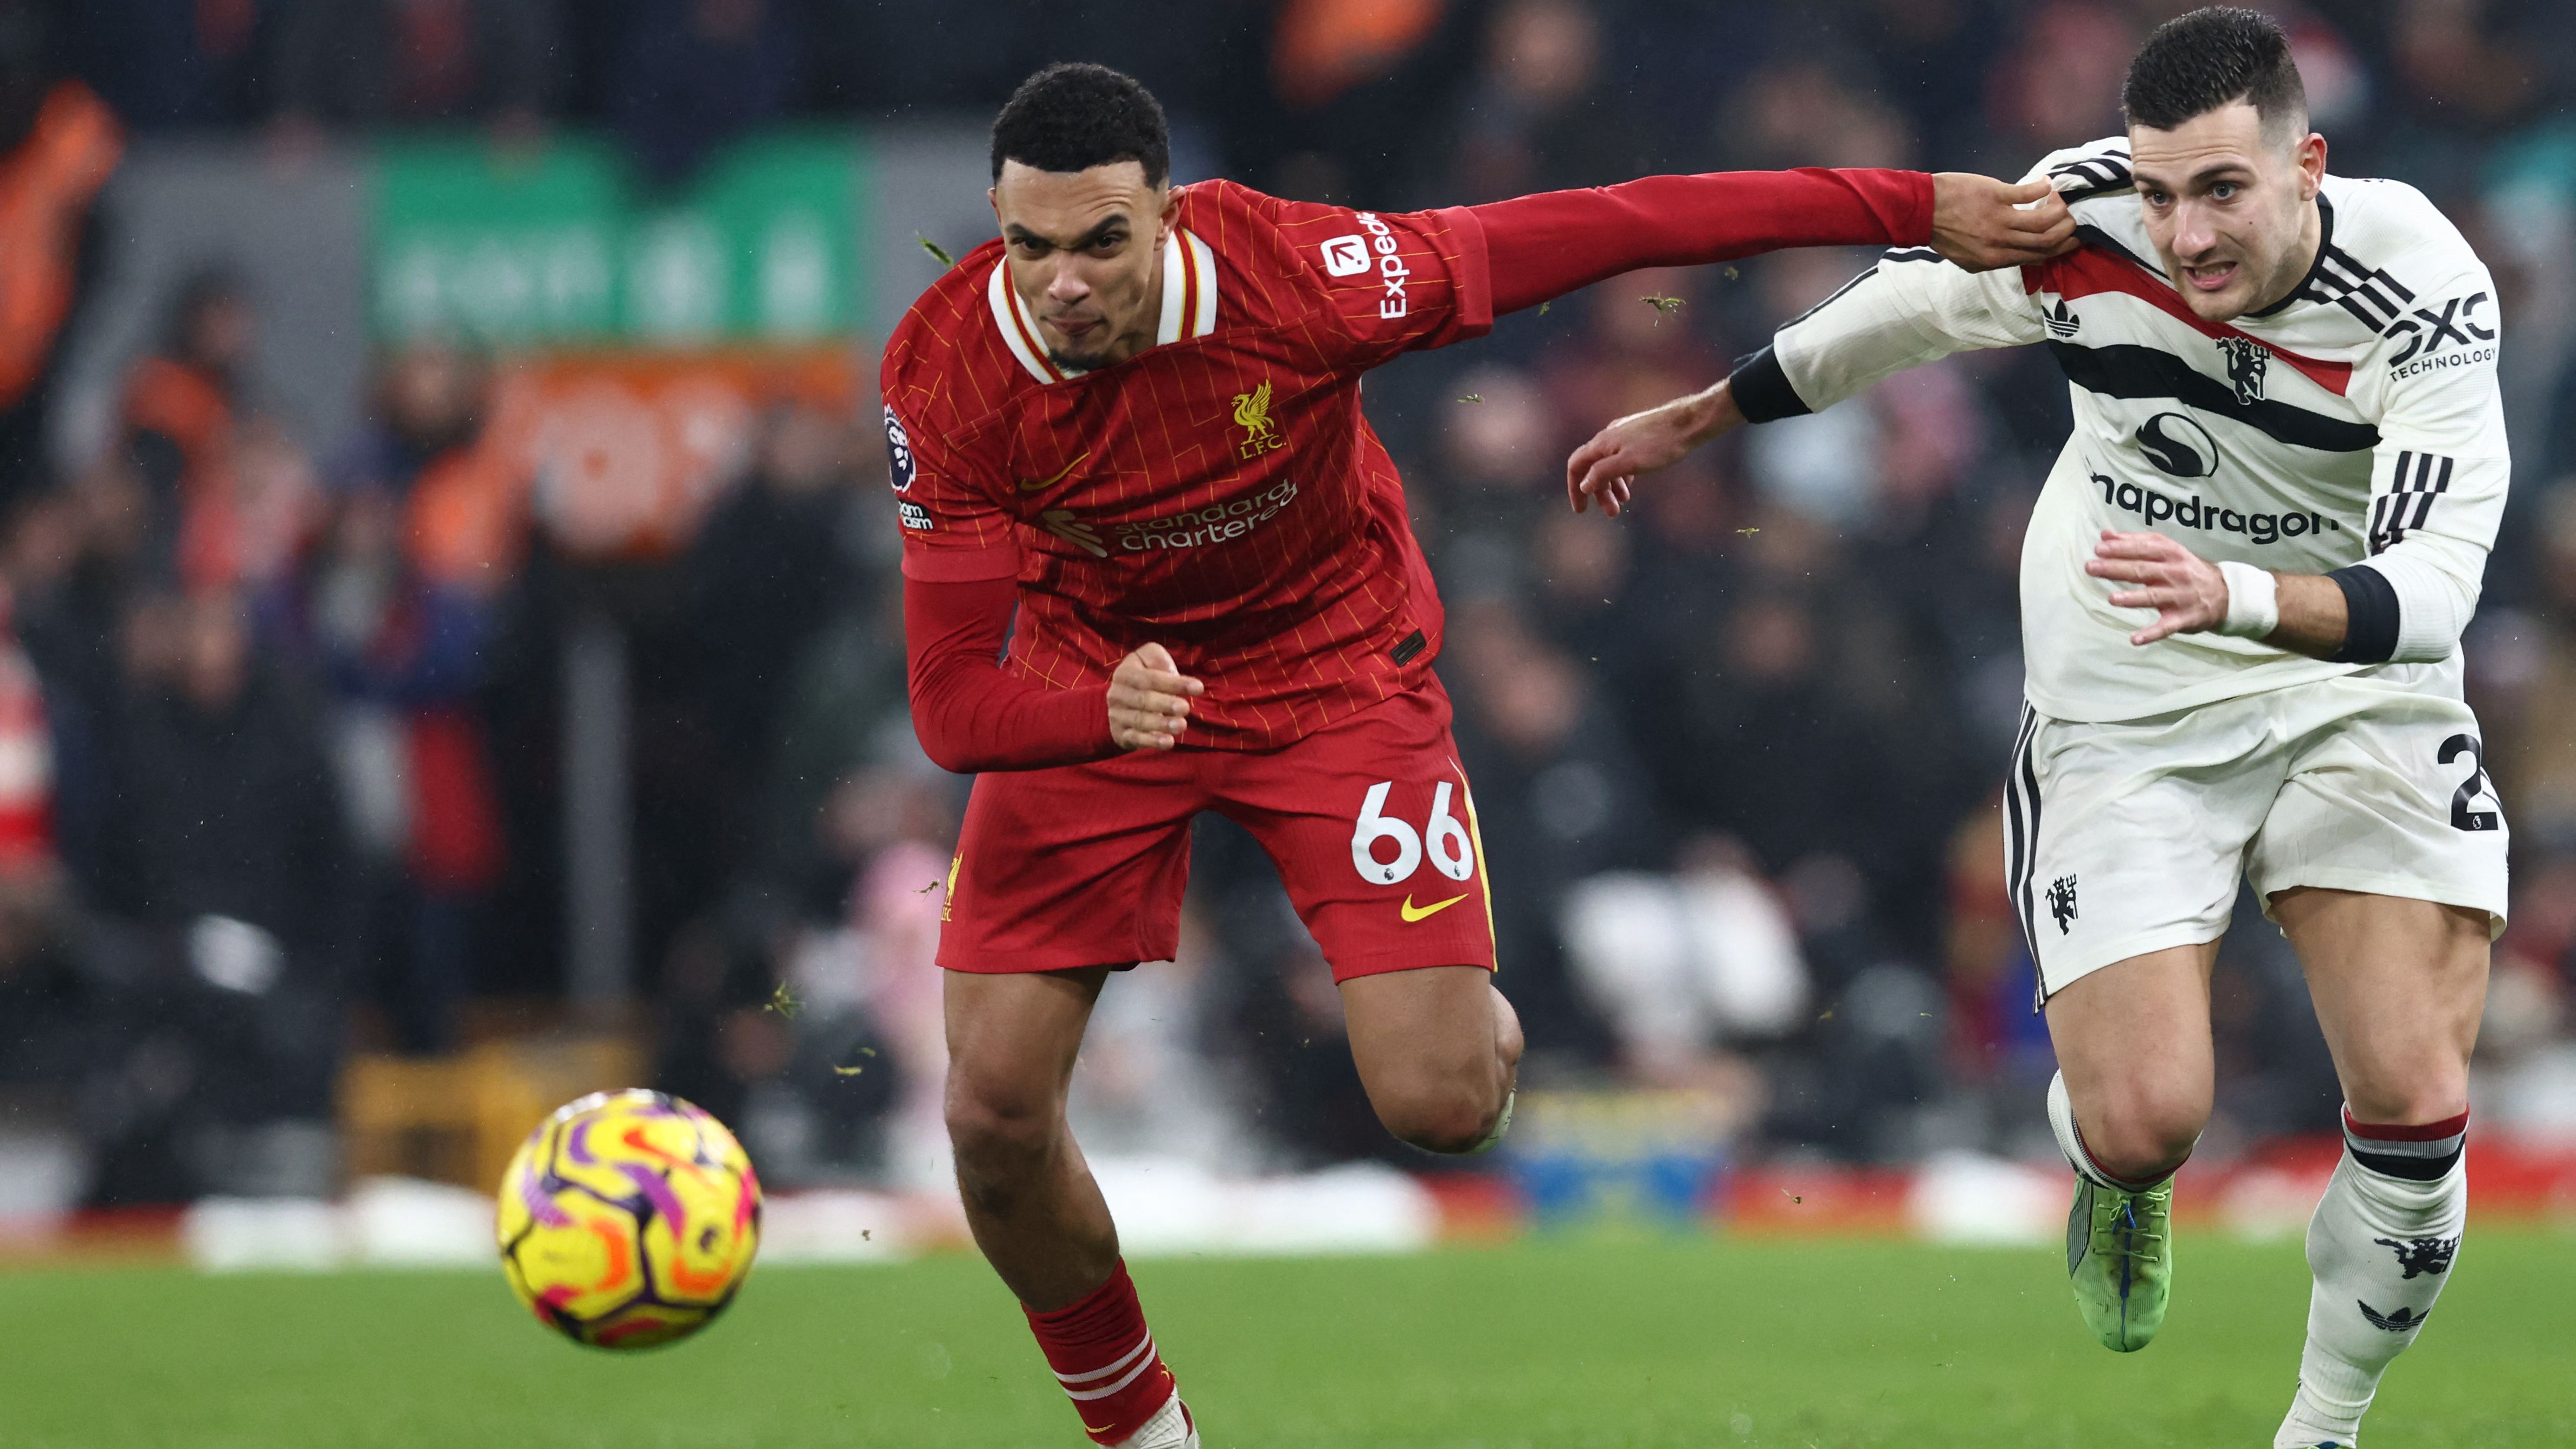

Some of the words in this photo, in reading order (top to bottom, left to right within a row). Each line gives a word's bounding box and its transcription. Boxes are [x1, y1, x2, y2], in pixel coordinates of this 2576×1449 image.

[2383, 292, 2495, 368] DXC
[2390, 347, 2496, 382] TECHNOLOGY
[1115, 478, 1290, 534] standard
[1122, 482, 1297, 550] chartered
[2085, 455, 2339, 544] napdragon
[1351, 781, 1474, 885] 66
